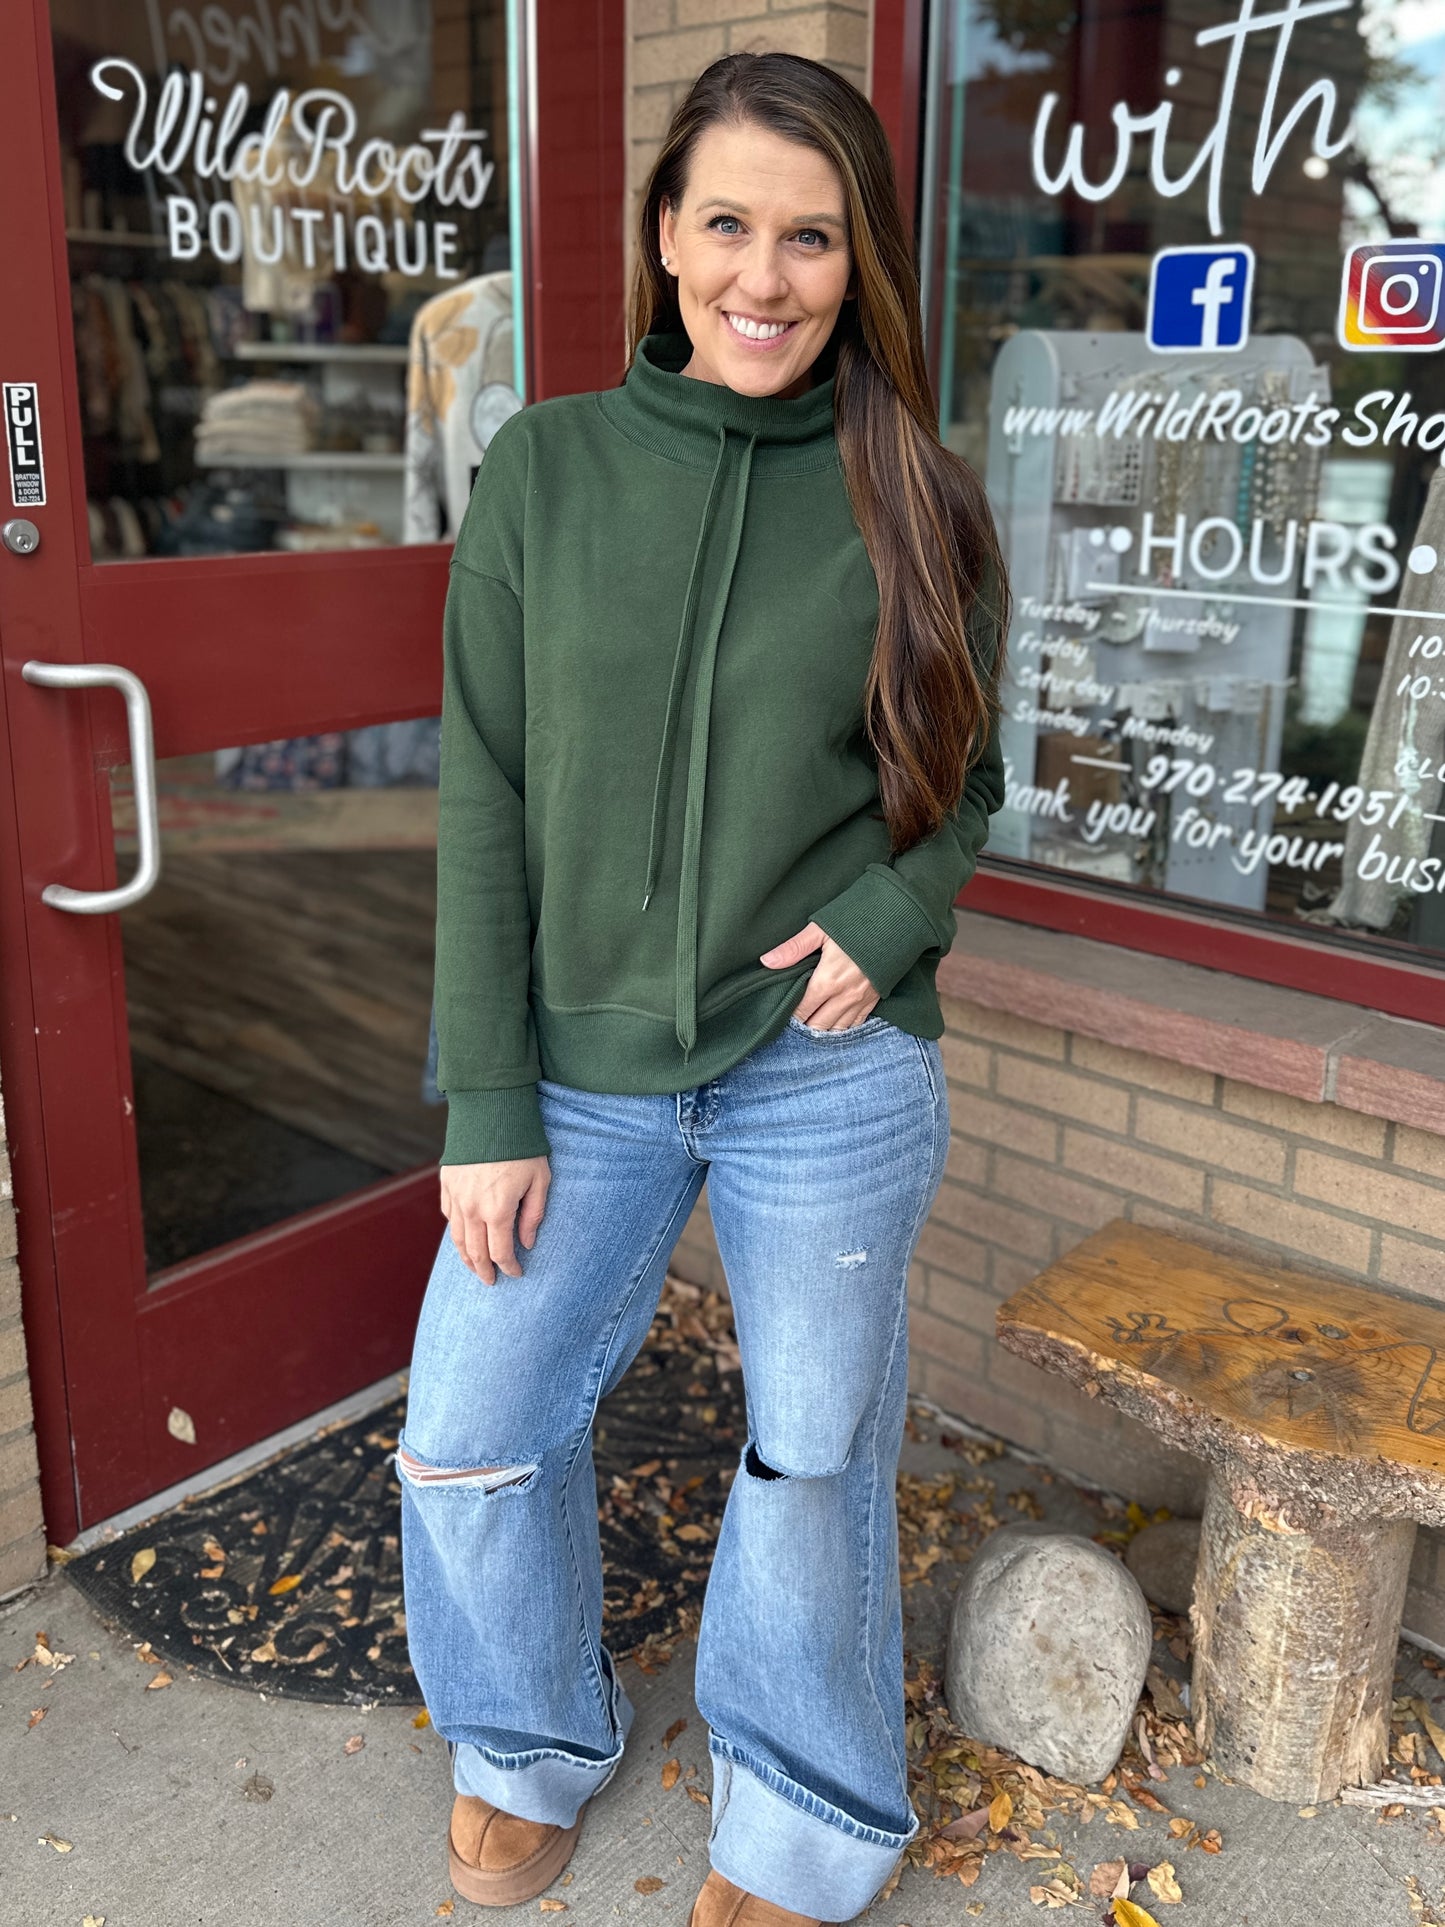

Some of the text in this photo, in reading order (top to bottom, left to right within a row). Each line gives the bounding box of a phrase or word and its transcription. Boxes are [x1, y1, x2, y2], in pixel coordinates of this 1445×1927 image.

[91, 58, 494, 208] Wild Roots
[1032, 0, 1356, 236] with
[167, 196, 459, 279] BOUTIQUE
[10, 387, 36, 466] PULL
[1002, 388, 1445, 468] www.WildRootsSho
[15, 473, 40, 481] BRATTON
[1138, 511, 1400, 595] HOURS
[1016, 630, 1089, 667] Friday
[1020, 597, 1101, 630] Tuesday
[1135, 607, 1240, 645] Thursday
[1015, 666, 1115, 704] Saturday
[1396, 674, 1445, 699] 10:
[1013, 700, 1091, 737] Sunday
[1121, 717, 1215, 755] Monday
[1003, 757, 1075, 823] hank
[1080, 799, 1157, 844] you
[1172, 806, 1232, 849] for
[1231, 829, 1345, 876] your
